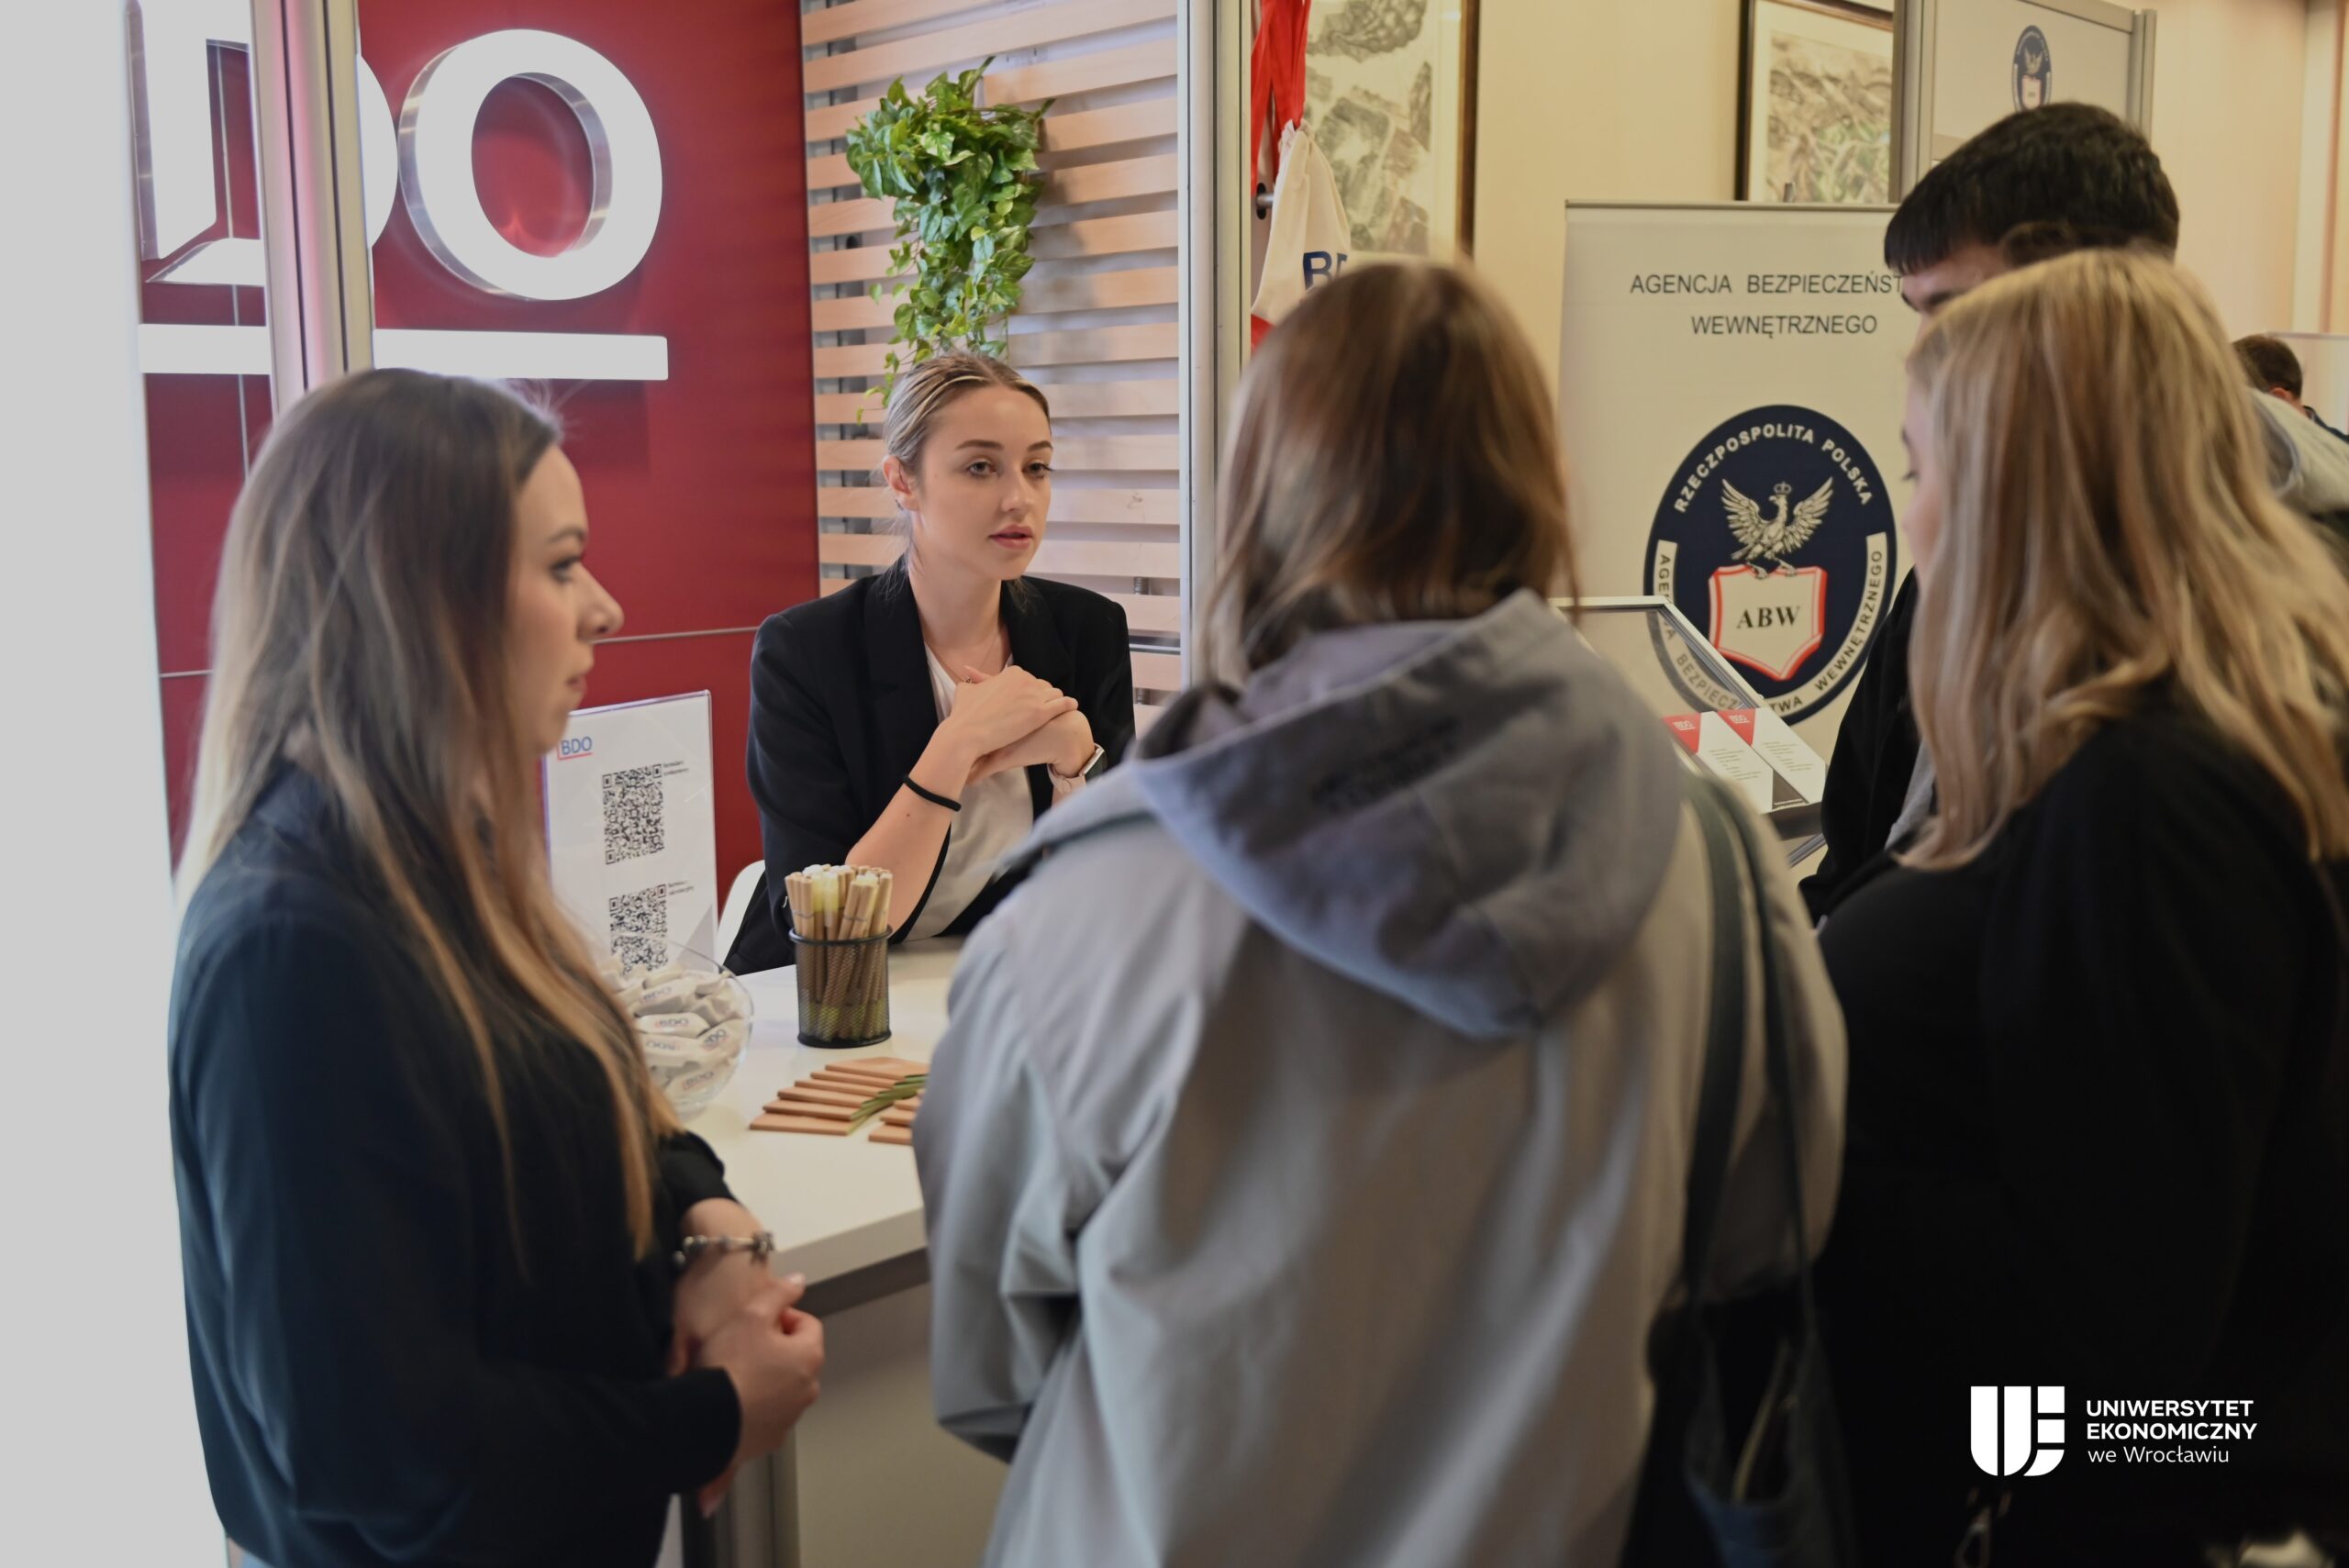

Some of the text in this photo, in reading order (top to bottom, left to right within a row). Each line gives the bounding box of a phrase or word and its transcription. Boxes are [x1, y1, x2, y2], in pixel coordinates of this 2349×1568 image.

[1630, 271, 1904, 294] AGENCJA BEZPIECZEŃST
[1691, 315, 1877, 339] WEWNĘTRZNEGO
[1674, 423, 1873, 513] RZECZPOSPOLITA POLSKA
[1736, 606, 1801, 629] ABW
[561, 736, 593, 756] BDO
